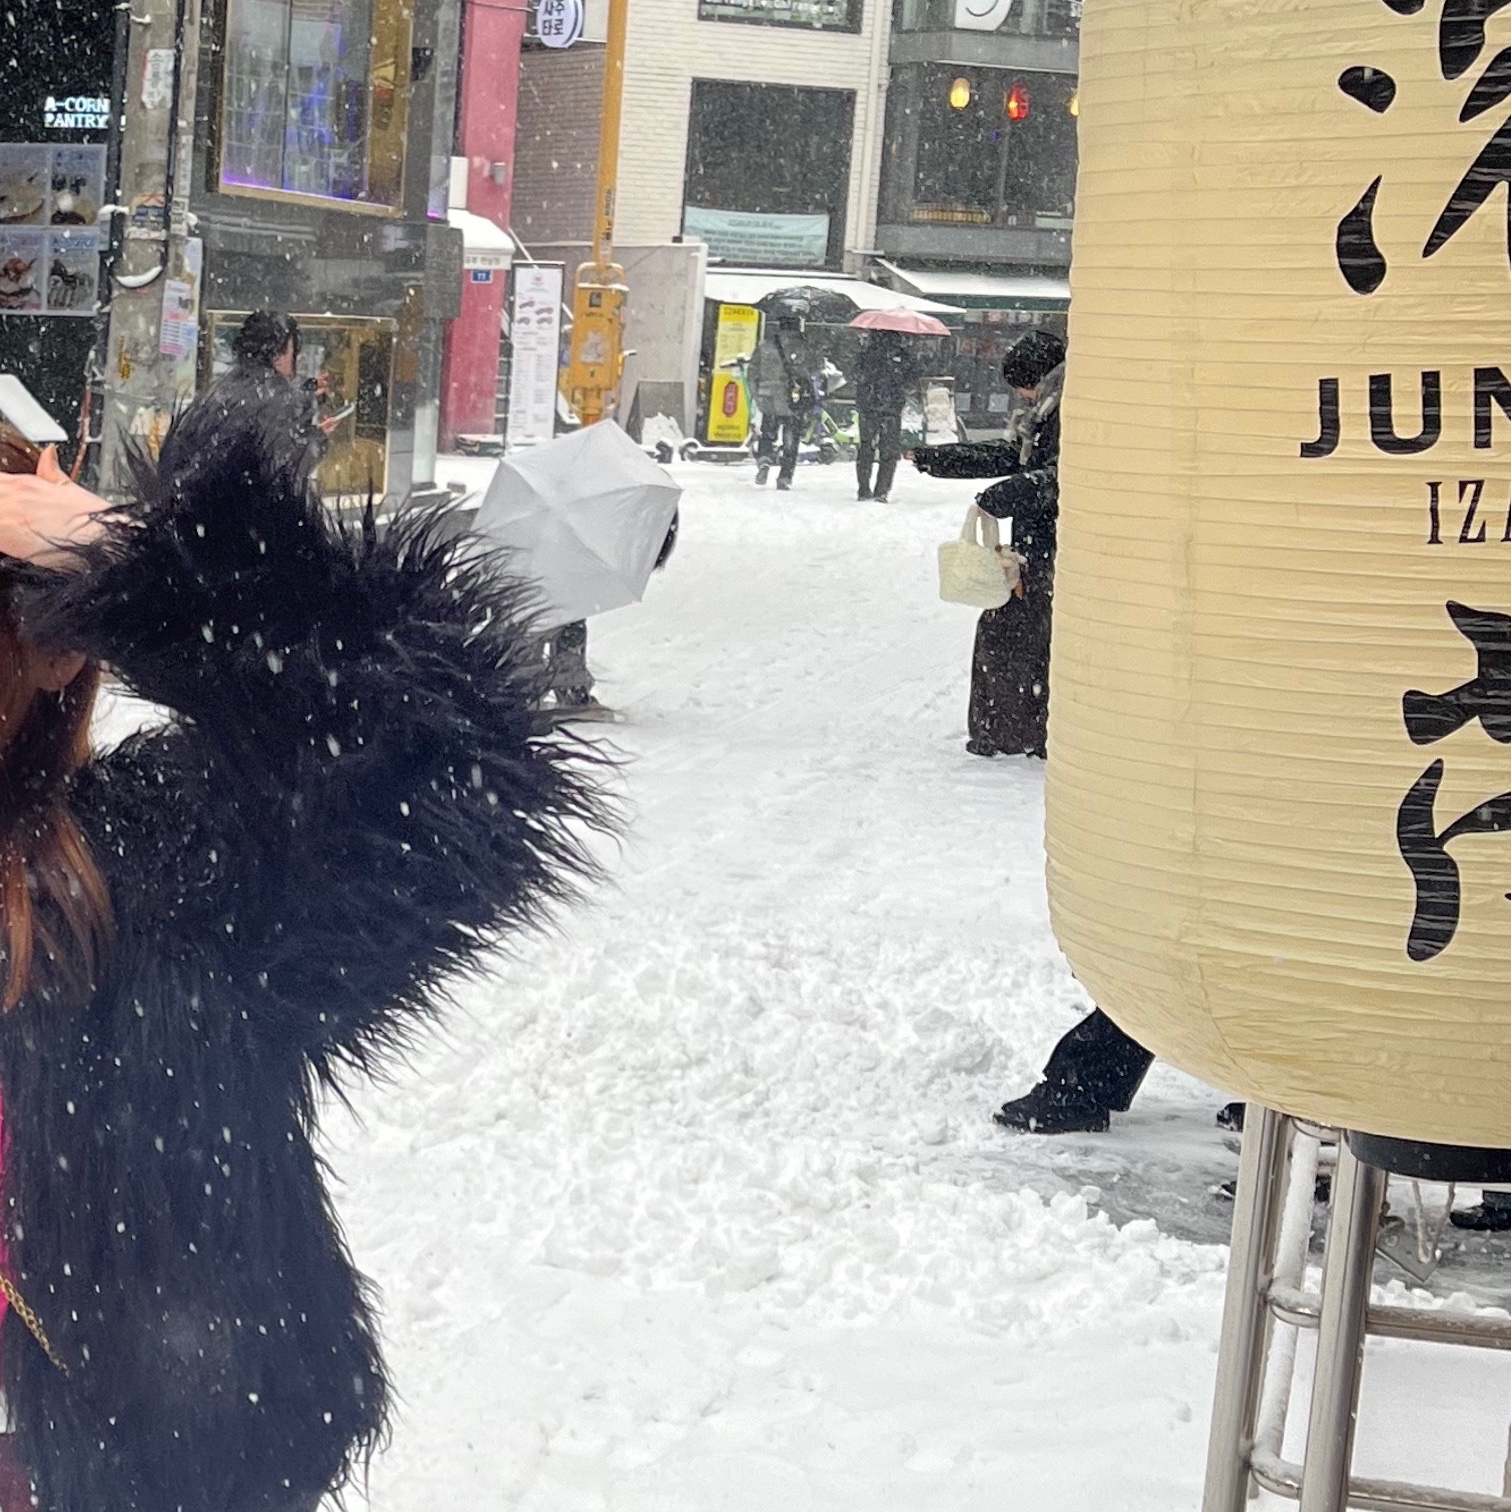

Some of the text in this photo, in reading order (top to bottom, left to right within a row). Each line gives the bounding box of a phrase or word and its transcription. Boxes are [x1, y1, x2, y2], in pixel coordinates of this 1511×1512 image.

[543, 0, 565, 16] 사주
[542, 18, 564, 36] 타로
[44, 96, 111, 113] A-CORN
[44, 113, 109, 129] PANTRY
[1426, 480, 1511, 545] IZ
